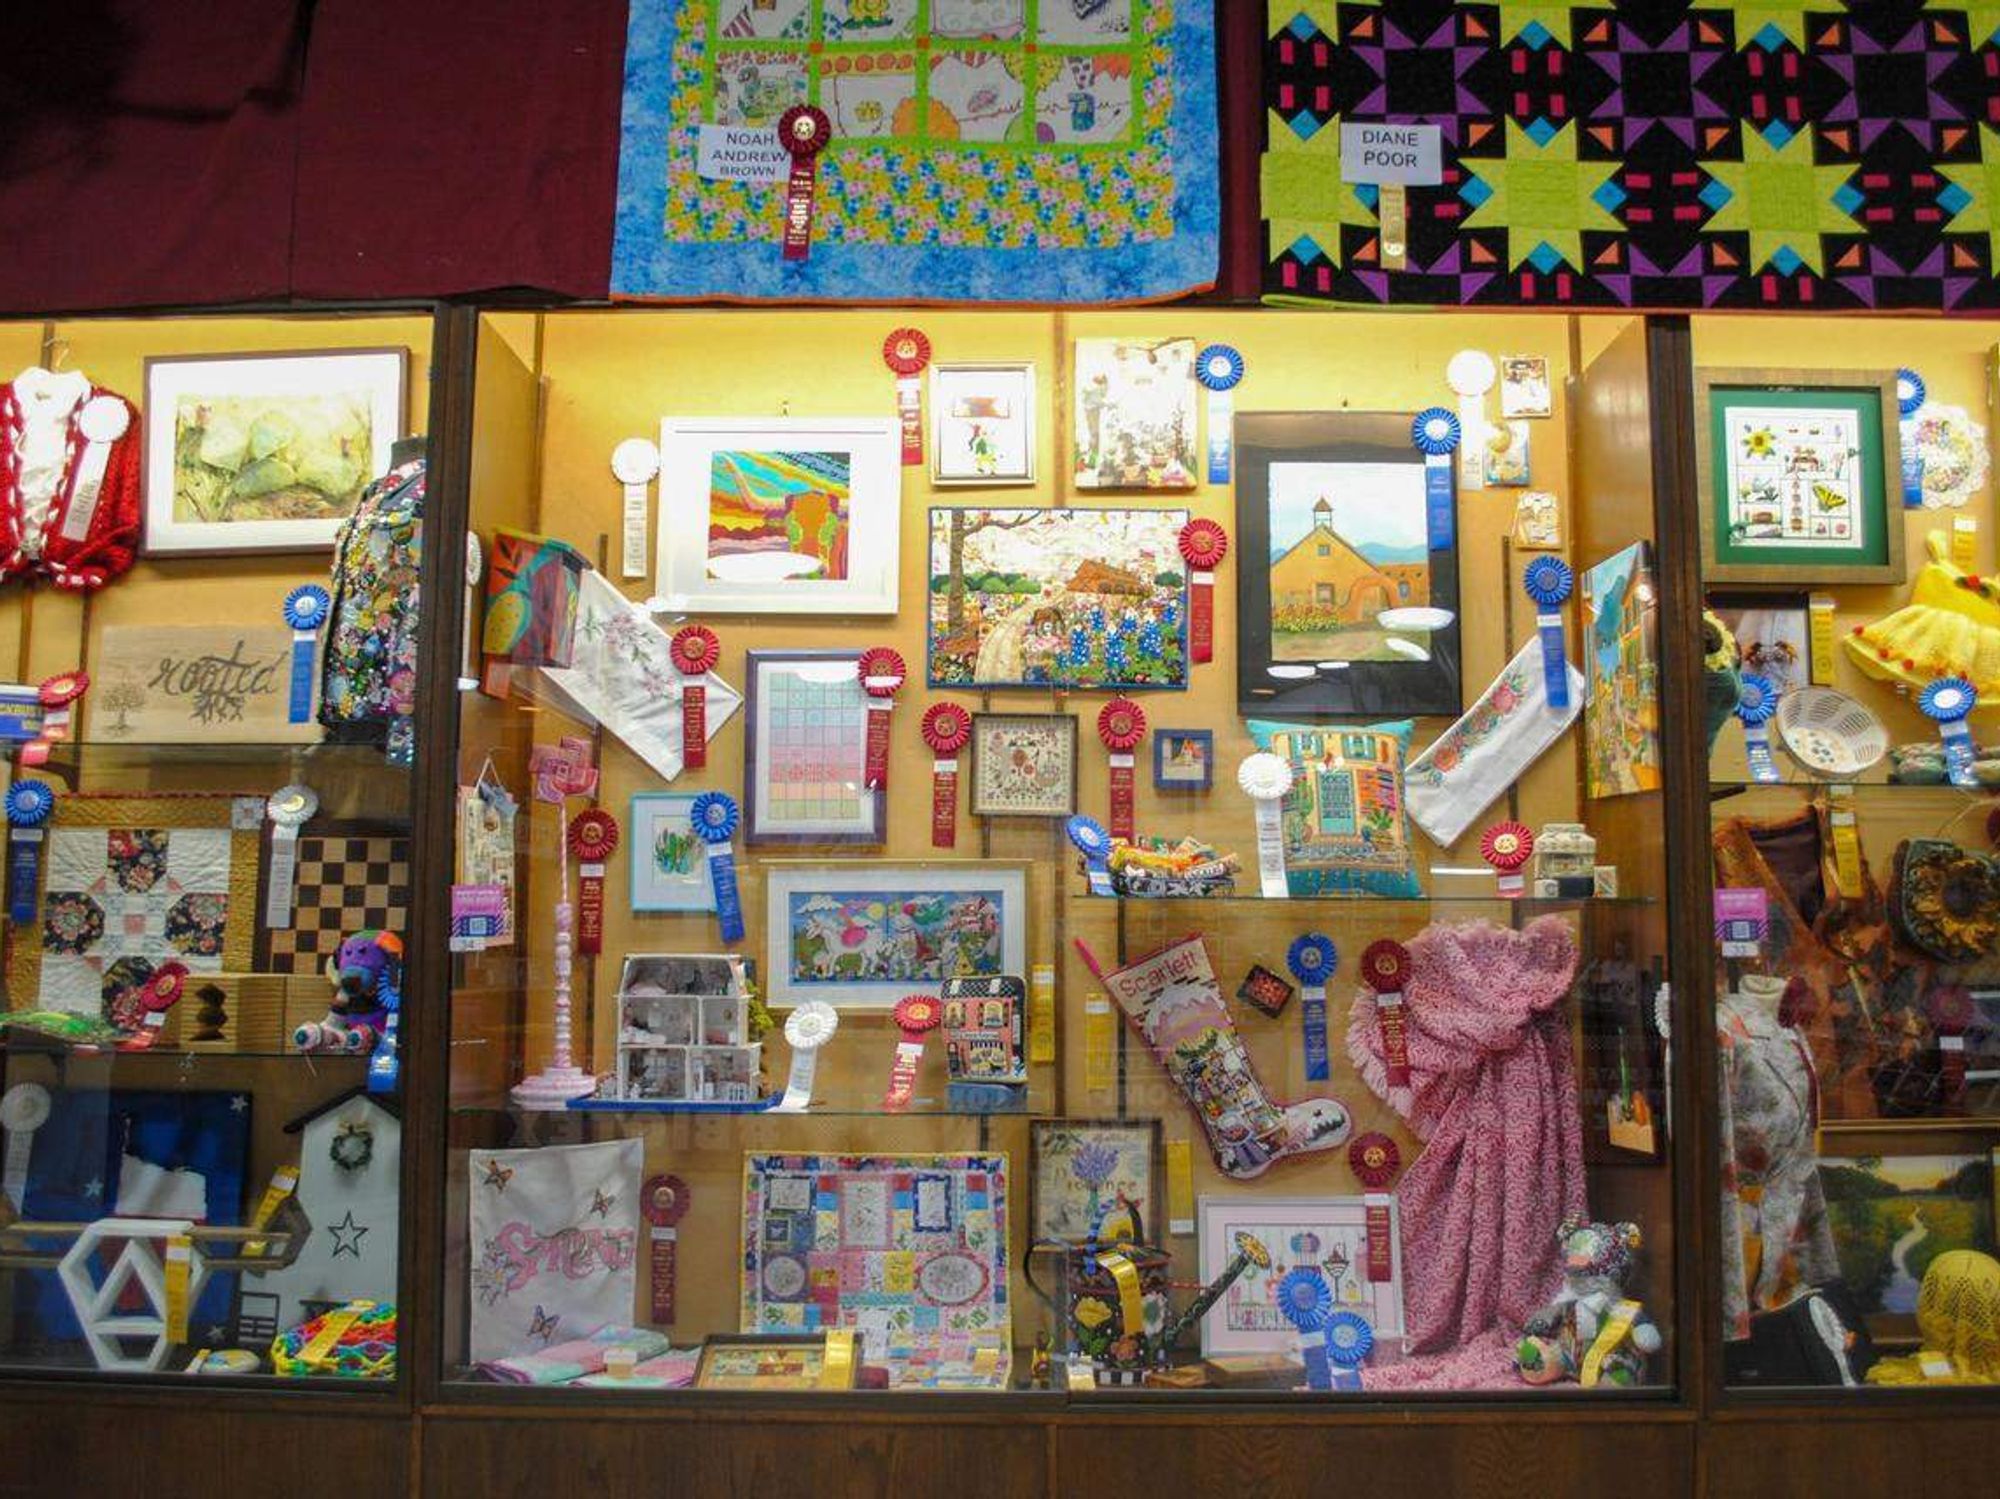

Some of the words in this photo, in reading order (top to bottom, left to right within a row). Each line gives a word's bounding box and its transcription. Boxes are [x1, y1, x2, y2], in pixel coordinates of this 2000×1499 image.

[726, 132, 775, 146] NOAH
[1362, 130, 1419, 147] DIANE
[712, 149, 788, 163] ANDREW
[1364, 150, 1418, 168] POOR
[720, 165, 776, 177] BROWN
[147, 639, 289, 697] rooted
[1119, 950, 1198, 998] Scarlett
